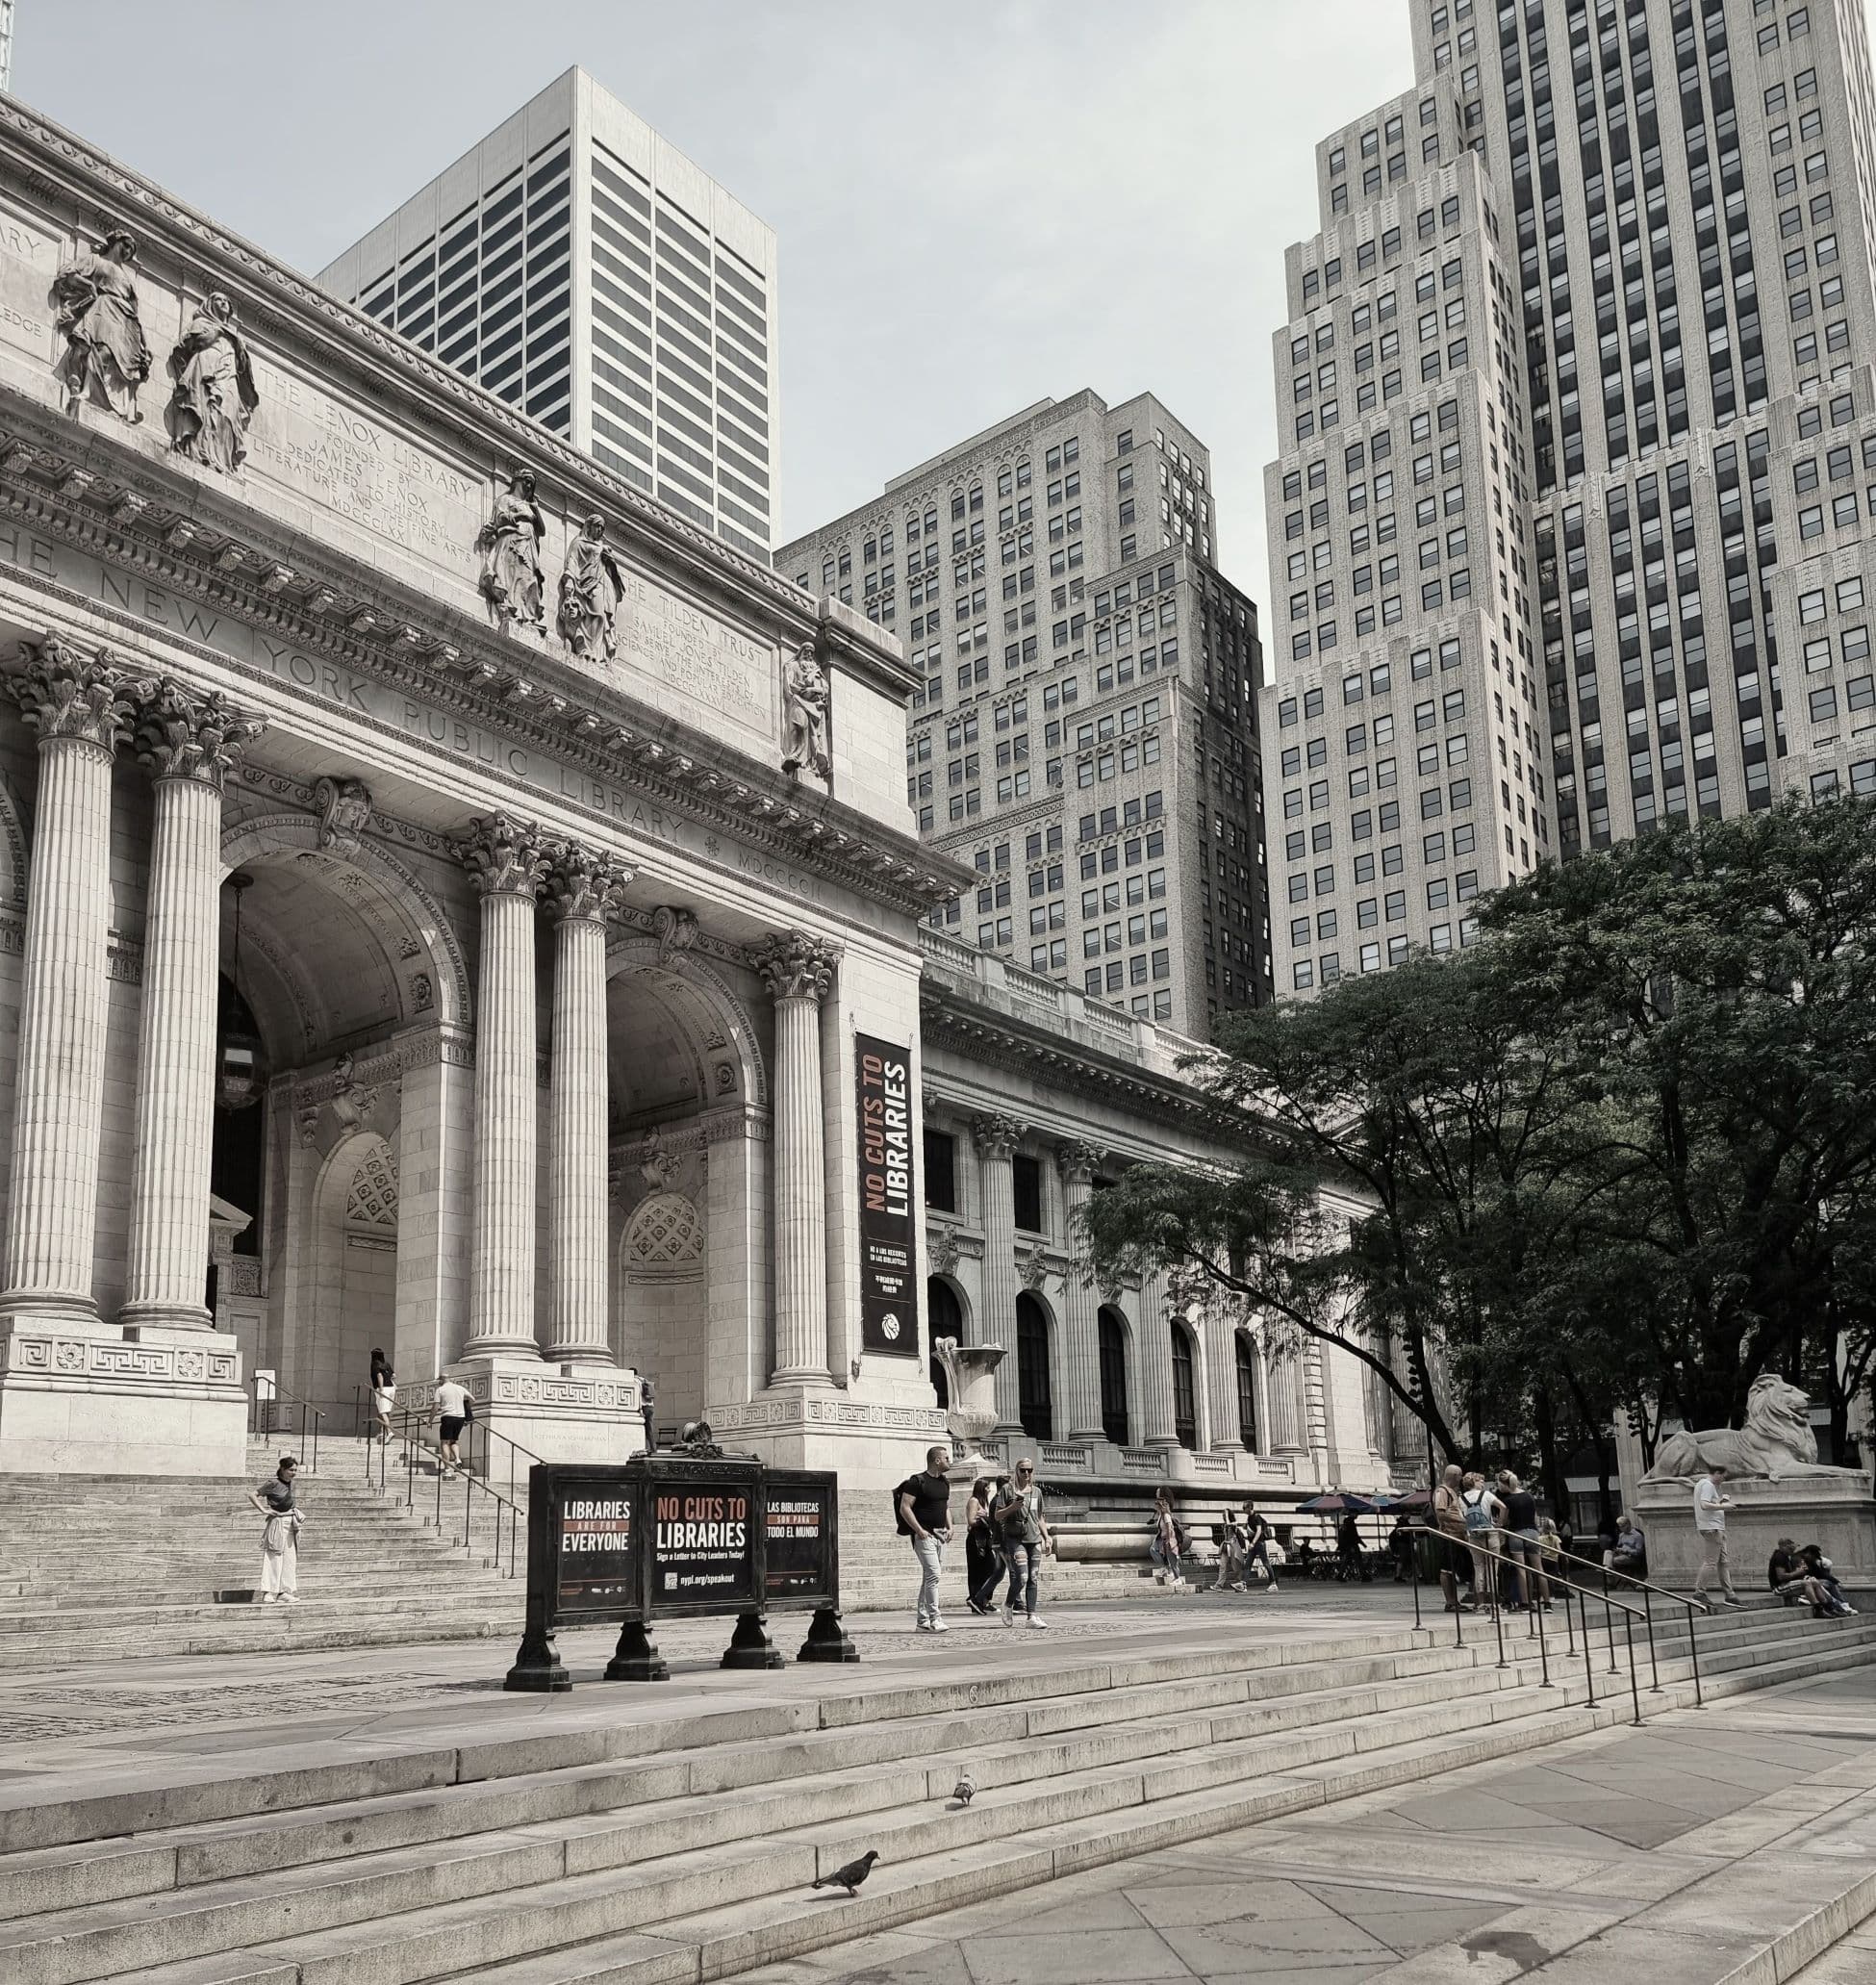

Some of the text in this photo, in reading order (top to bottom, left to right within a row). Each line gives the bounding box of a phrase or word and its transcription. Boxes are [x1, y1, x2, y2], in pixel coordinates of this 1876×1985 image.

[0, 307, 42, 337] EDGE
[259, 367, 471, 500] THE LENOX LIBRARY
[288, 442, 359, 488] DEDICATED
[367, 484, 384, 501] TO
[326, 432, 411, 489] FOUNDED BY
[308, 440, 427, 513] JAMES LENOX
[253, 438, 471, 564] LITERATURE AND THE FINE ARTS
[659, 595, 763, 667] TILDEN TRUST
[675, 651, 693, 669] THE
[680, 642, 712, 668] JONES
[718, 661, 750, 688] TILDEN
[96, 569, 219, 642] NEW
[260, 637, 370, 713] YORK
[404, 701, 528, 776] PUBLIC
[559, 769, 684, 843] LIBRARY
[862, 1054, 886, 1212] NO CUTS TO
[883, 1060, 909, 1217] LIBRARIES
[564, 1500, 631, 1520] LIBRARIES
[657, 1497, 746, 1521] NO CUTS TO
[767, 1501, 820, 1514] LAS BIBLIOTECAS
[776, 1514, 810, 1524] SON PARA
[577, 1520, 617, 1531] ARE FOR
[656, 1522, 746, 1548] LIBRARIES
[767, 1526, 819, 1538] TODO EL MUNDO
[562, 1532, 629, 1553] EVERYONE
[656, 1552, 669, 1563] Sign
[673, 1551, 690, 1561] Letter
[697, 1551, 707, 1562] City
[707, 1550, 728, 1560] Leaders
[728, 1550, 745, 1561] Today!
[680, 1573, 735, 1587] nypl.org/speakout
